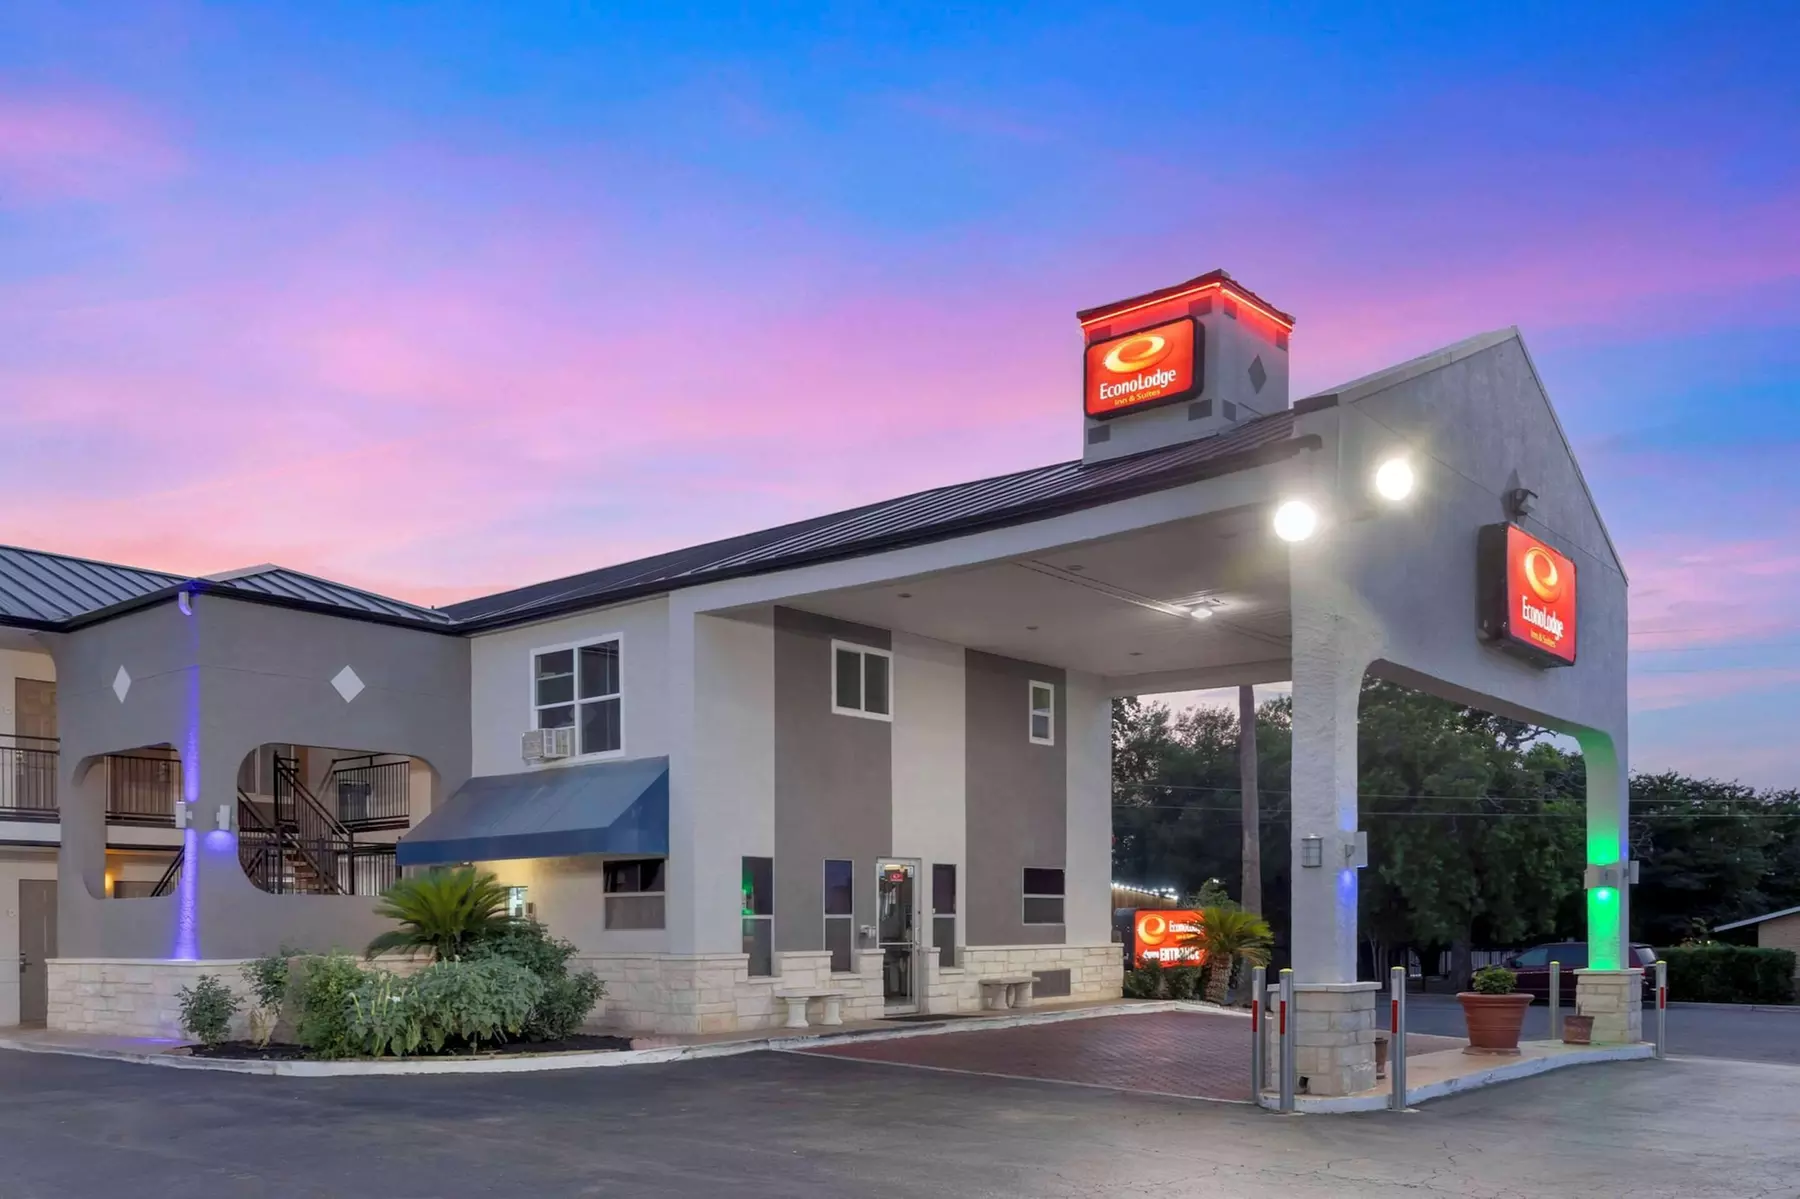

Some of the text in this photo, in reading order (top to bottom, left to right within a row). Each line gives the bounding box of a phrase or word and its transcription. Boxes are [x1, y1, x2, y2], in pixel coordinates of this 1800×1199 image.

[1100, 368, 1175, 399] EconoLodge
[1137, 389, 1160, 400] Suites
[1522, 595, 1563, 640] EconoLodge
